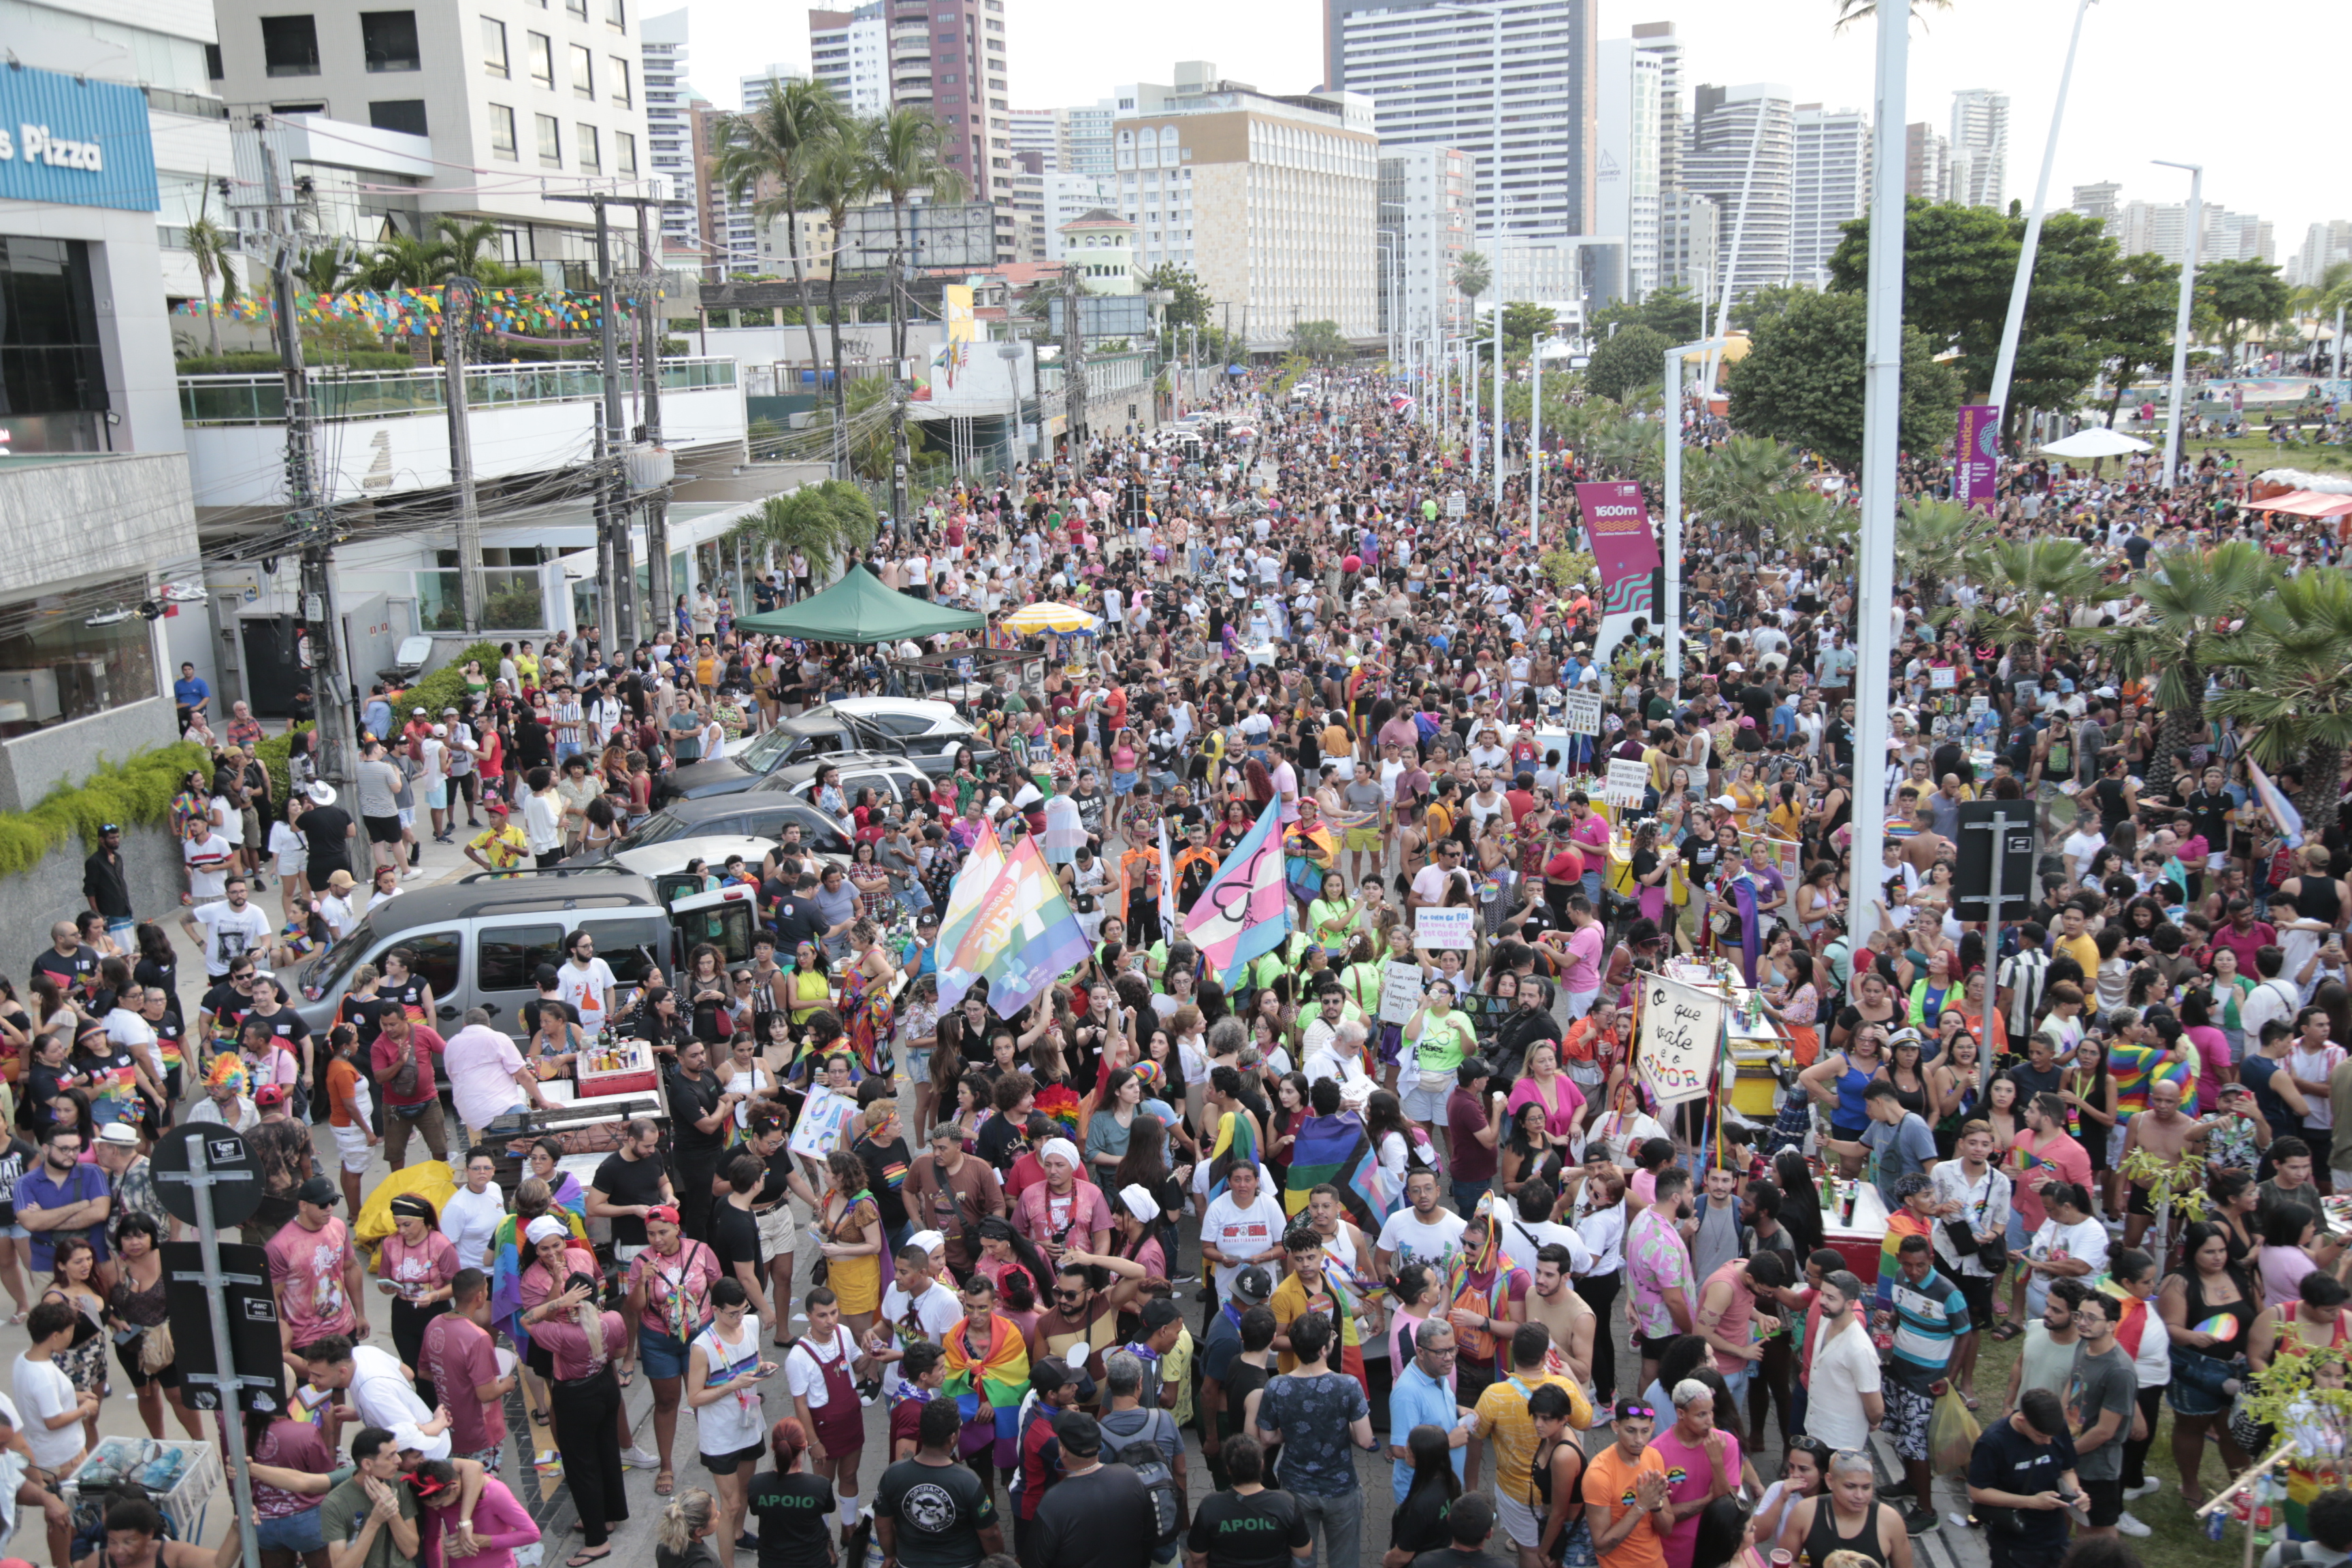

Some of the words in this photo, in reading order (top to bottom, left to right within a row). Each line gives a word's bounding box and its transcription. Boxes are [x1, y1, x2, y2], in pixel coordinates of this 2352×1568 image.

[21, 123, 103, 172] Pizza
[1960, 410, 1973, 461] Náuticas
[1595, 506, 1637, 517] 1600m
[1486, 998, 1520, 1013] AMO
[1652, 988, 1667, 1006] O
[1674, 1004, 1701, 1024] que
[1420, 1043, 1443, 1053] Mães
[1655, 1025, 1693, 1050] vale
[1661, 1046, 1667, 1058] é
[1672, 1055, 1681, 1064] o
[1644, 1054, 1700, 1088] AMOR
[811, 1096, 829, 1121] O
[757, 1494, 815, 1508] APOIO
